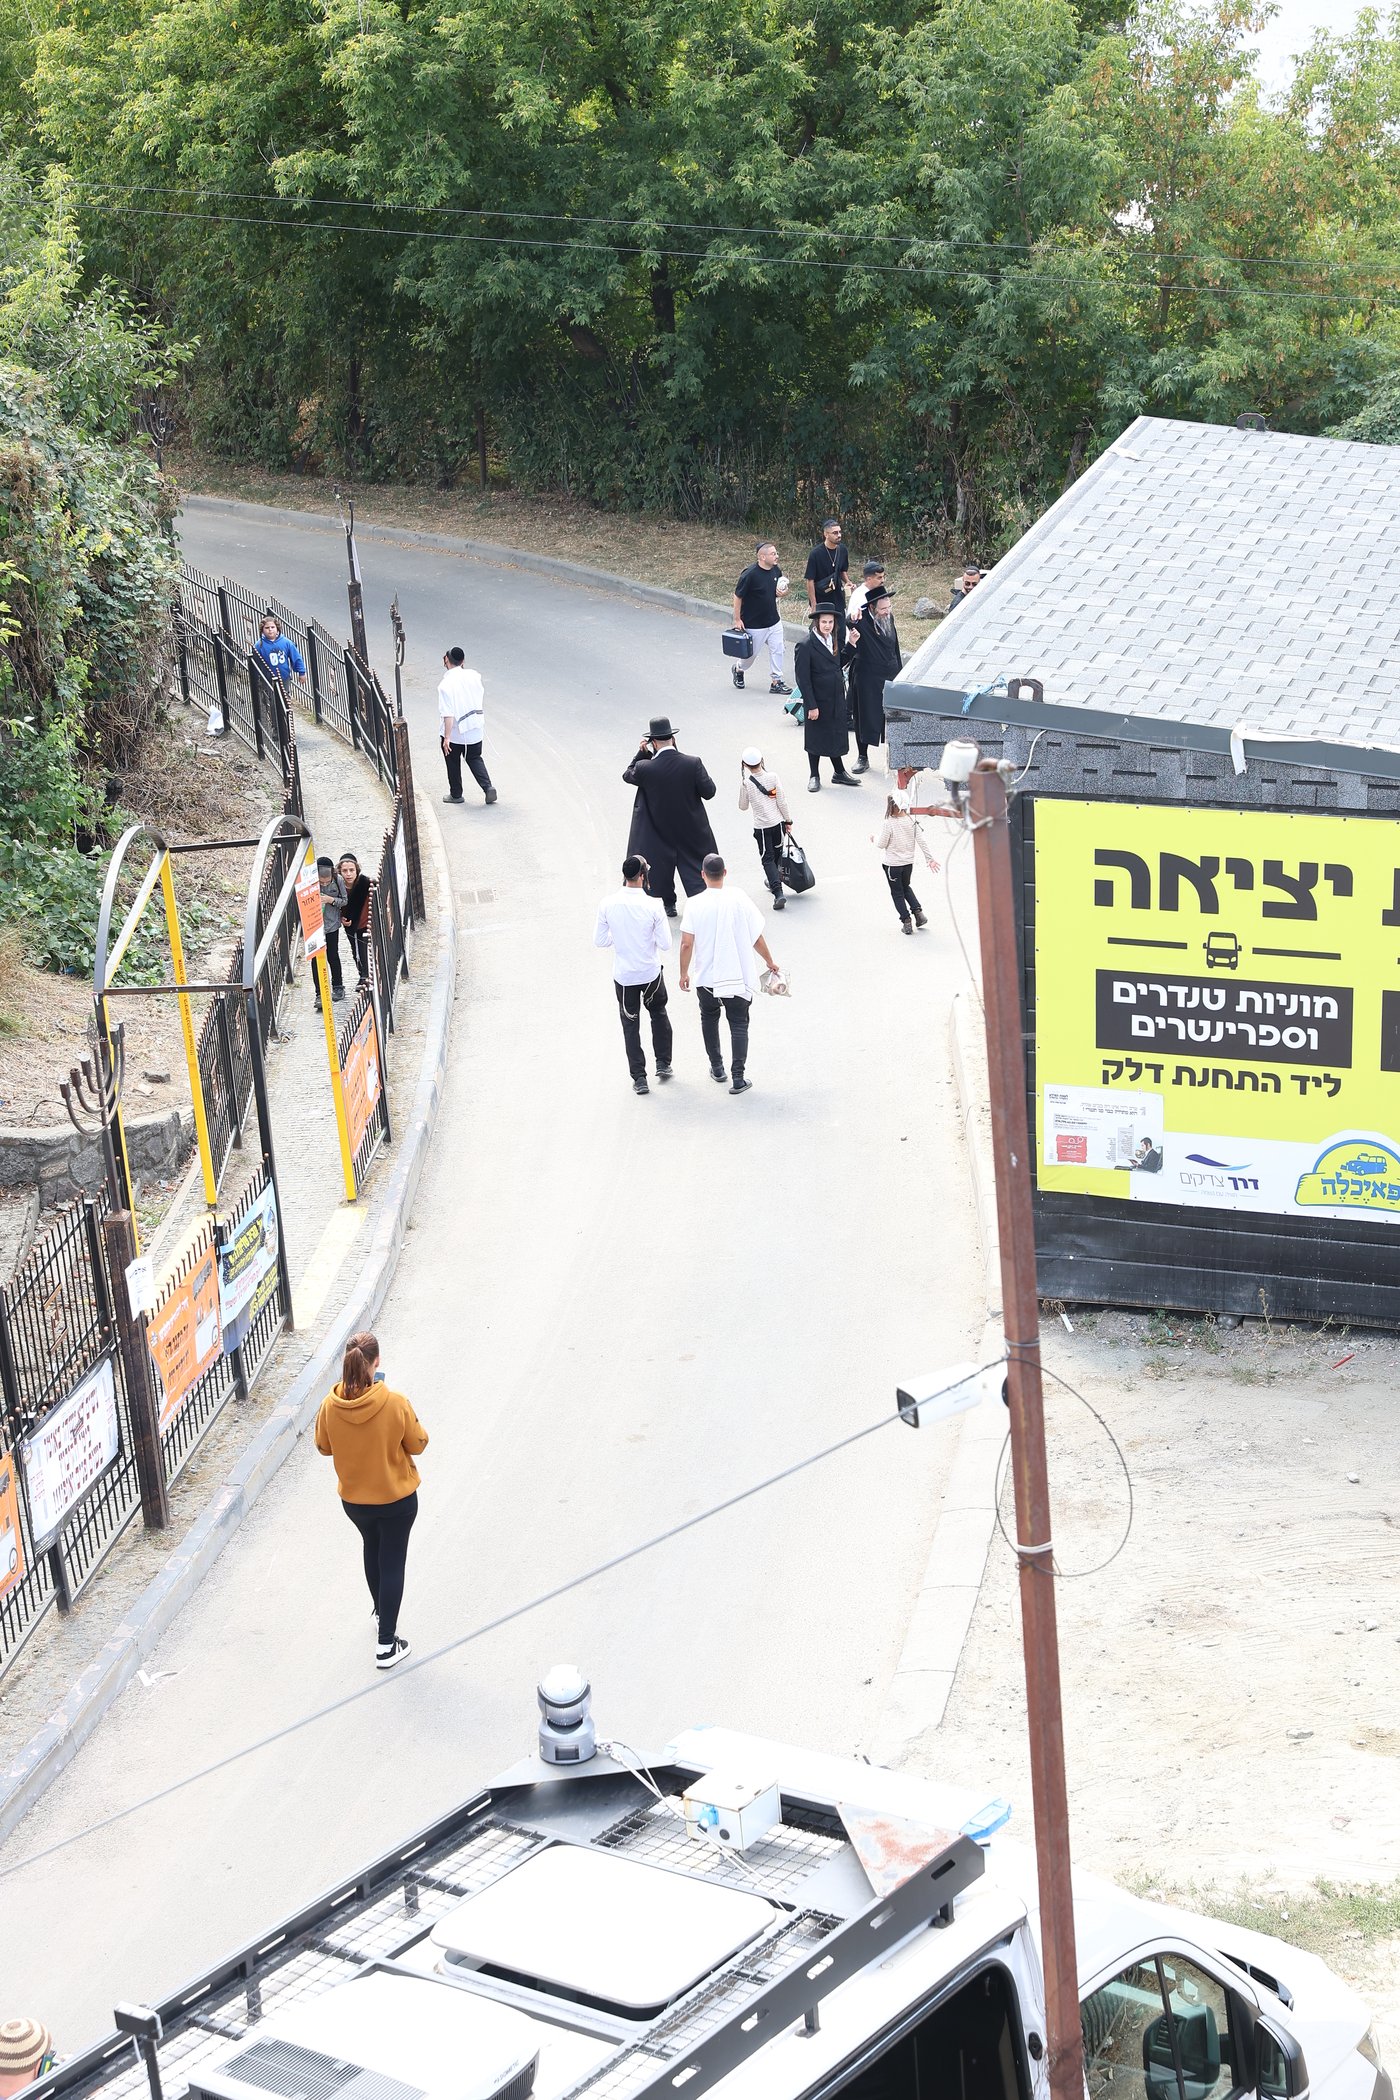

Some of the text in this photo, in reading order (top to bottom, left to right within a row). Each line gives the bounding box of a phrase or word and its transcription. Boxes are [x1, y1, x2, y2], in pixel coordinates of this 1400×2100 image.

[1094, 848, 1353, 921] יציאה
[1112, 980, 1339, 1020] מוניות טנדרים
[1131, 1015, 1319, 1050] וספרינטרים
[1101, 1057, 1342, 1098] ליד התחנת דלק
[1179, 1172, 1260, 1191] דרך צדיקים
